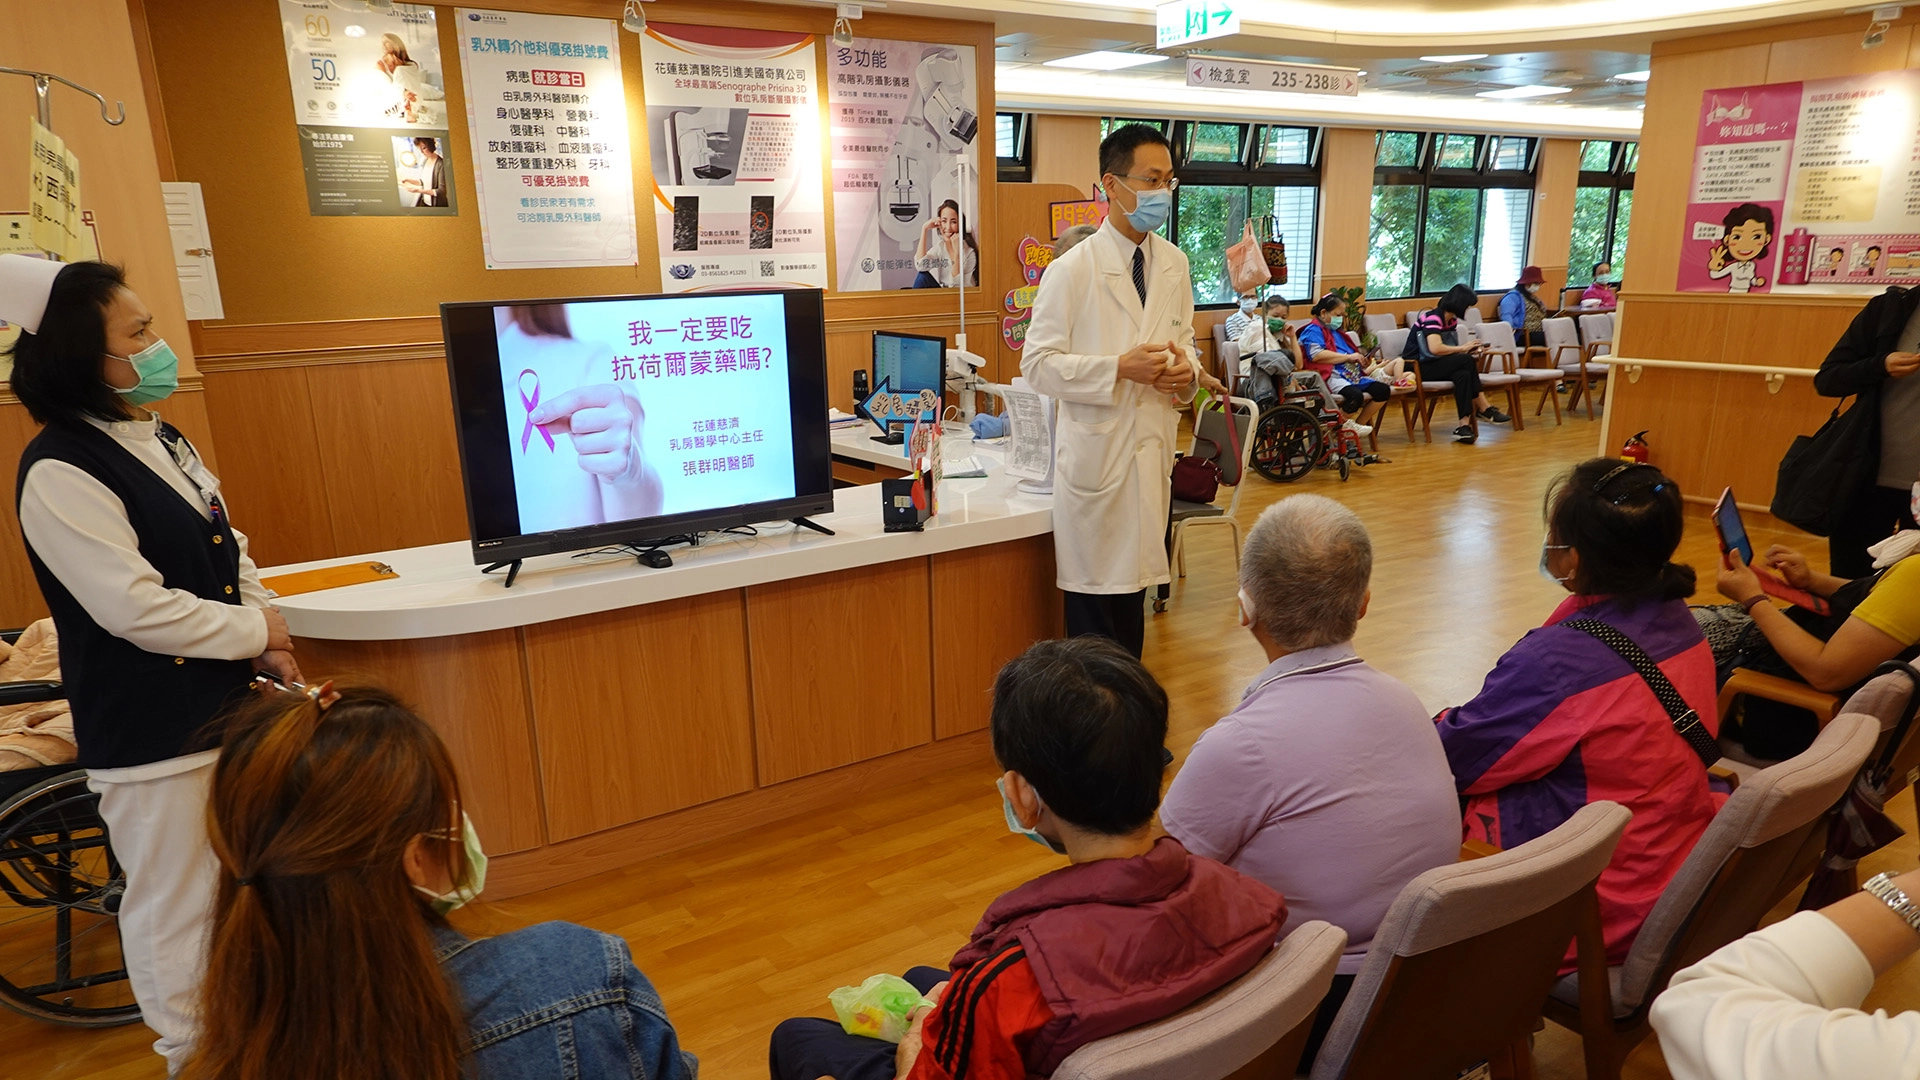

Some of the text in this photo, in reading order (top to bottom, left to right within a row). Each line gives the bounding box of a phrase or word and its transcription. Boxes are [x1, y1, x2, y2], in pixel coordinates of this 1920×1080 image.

[304, 14, 331, 37] 60
[471, 37, 609, 60] 乳外轉介他科優免掛號費
[837, 47, 887, 69] 多功能
[311, 58, 337, 82] 50
[505, 70, 583, 86] 病患 就診當日
[655, 62, 806, 81] 花蓮慈濟醫院引進美國奇異公司
[837, 73, 910, 88] 高階乳房攝影儀器
[1208, 66, 1340, 91] 檢查室 235-238診
[674, 78, 807, 93] 全球最高端Senographe Prisina 3D
[502, 91, 590, 105] 由乳房外科醫師轉介
[857, 108, 874, 116] Times
[521, 175, 590, 187] 可優免掛號費
[1051, 204, 1100, 239] 門診
[628, 315, 753, 346] 我一定要吃
[611, 347, 772, 381] 抗荷爾蒙藥嗎?
[692, 417, 740, 433] 花蓮慈濟
[669, 430, 764, 451] 乳房醫學中心主任
[683, 455, 755, 476] 張群明醫師
